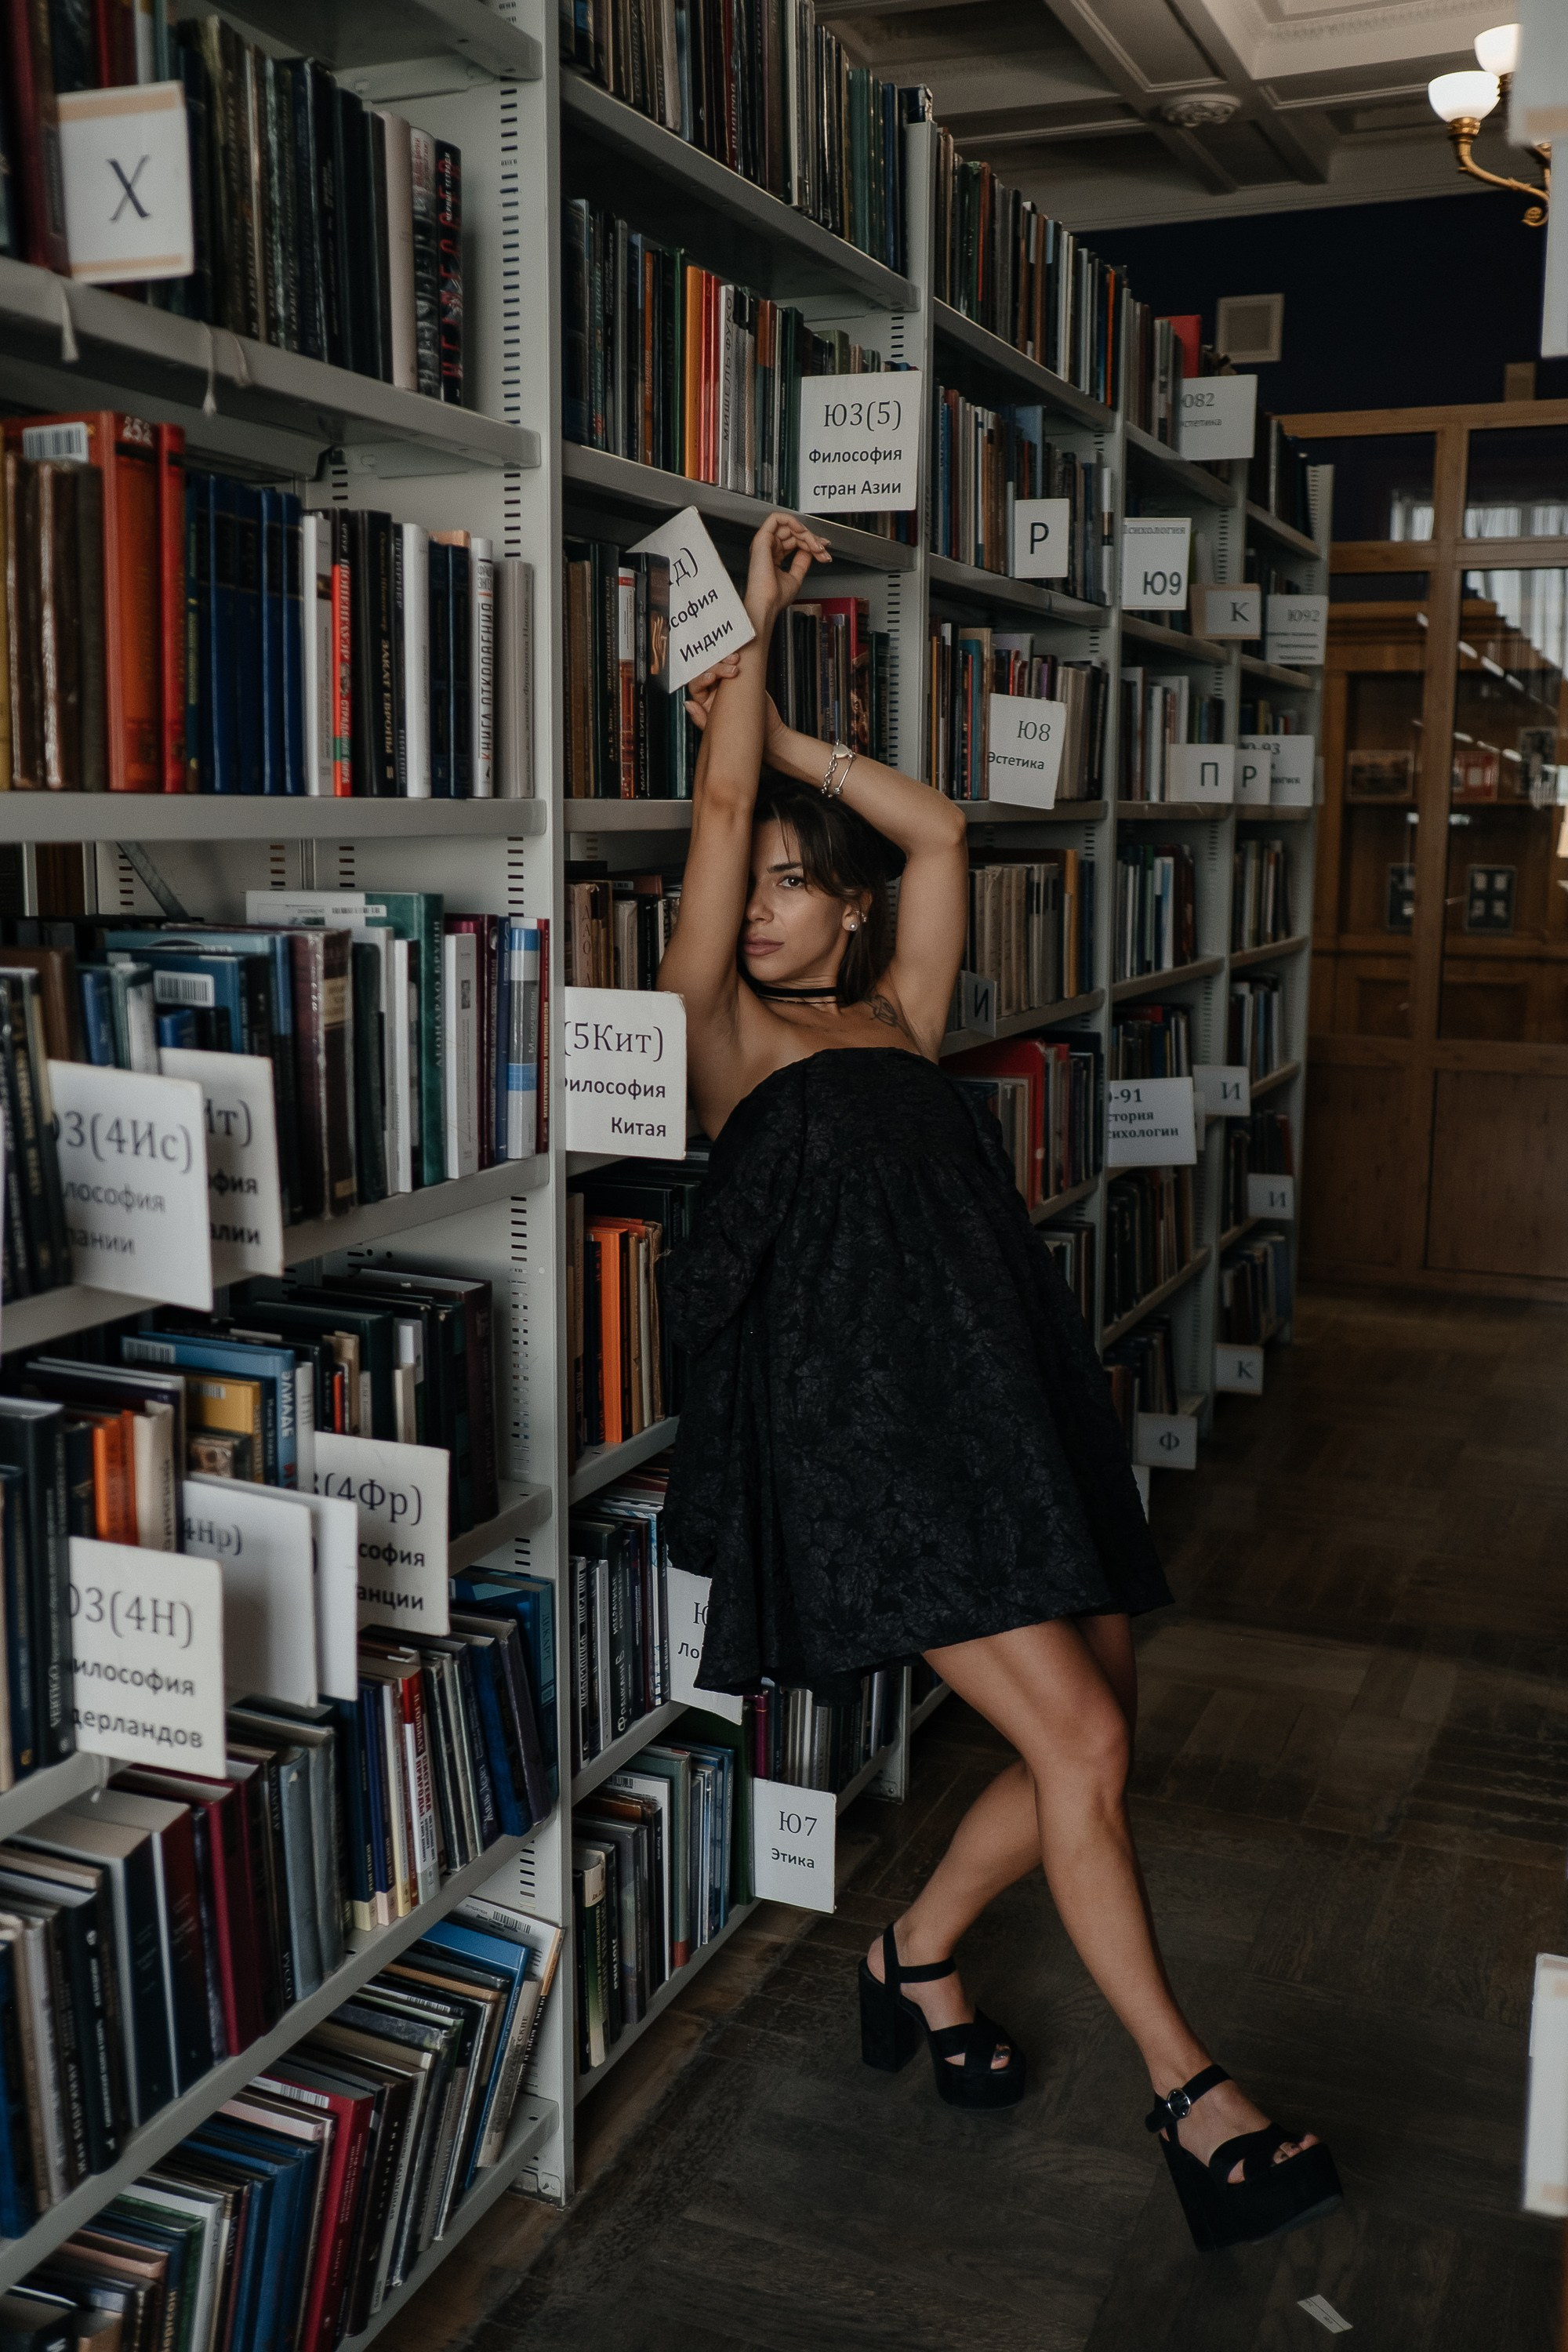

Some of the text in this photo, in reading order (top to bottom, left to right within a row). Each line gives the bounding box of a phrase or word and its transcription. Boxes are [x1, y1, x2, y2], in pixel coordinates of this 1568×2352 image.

[720, 296, 733, 441] МИШЕЛЬ ФУКО
[808, 446, 902, 465] Философия
[813, 480, 902, 499] стран Азии
[1029, 521, 1050, 555] Р
[1142, 571, 1182, 596] Ю9
[669, 588, 719, 632] софия
[1230, 601, 1250, 622] К
[679, 619, 734, 662] Индии
[480, 602, 492, 761] КНИГА ОТКРОВЕНИЯ
[381, 638, 393, 754] ЗАКАТ ЕВРОПЫ
[1017, 720, 1051, 742] Ю8
[988, 750, 1045, 771] Эстетика
[1200, 761, 1219, 787] П
[1240, 764, 1258, 789] Р
[1221, 1081, 1241, 1101] И
[611, 1116, 666, 1138] Китая
[1237, 1360, 1253, 1379] К
[1158, 1431, 1181, 1452] Ф
[579, 1634, 589, 1708] ФИЛОСОФИЯ
[48, 1664, 61, 1727] VERTIGO
[415, 1759, 426, 1819] ПРИРОДЫ
[420, 1754, 433, 1813] СИСТЕМА
[779, 1810, 818, 1837] Ю7
[771, 1846, 815, 1870] Этика
[612, 1938, 620, 1990] Логика
